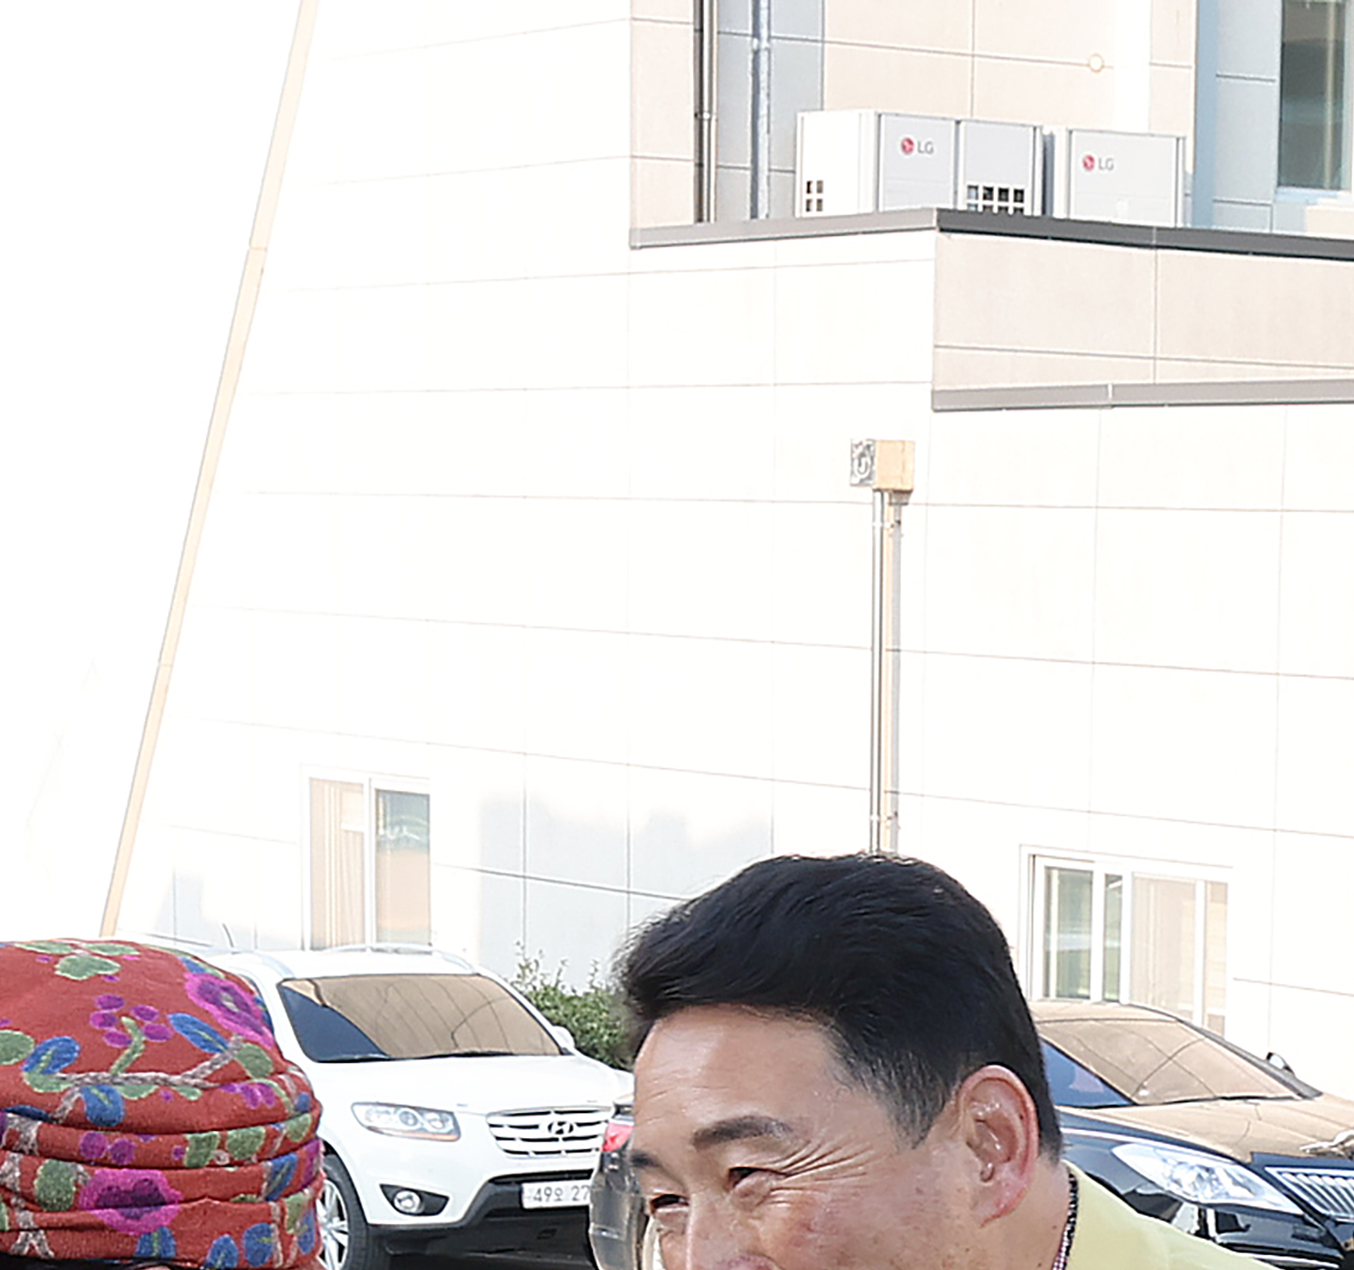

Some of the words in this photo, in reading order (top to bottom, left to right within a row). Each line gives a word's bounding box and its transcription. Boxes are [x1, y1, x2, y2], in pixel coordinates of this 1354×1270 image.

[917, 140, 935, 154] LG
[1098, 158, 1115, 171] LG
[571, 1184, 591, 1202] 27
